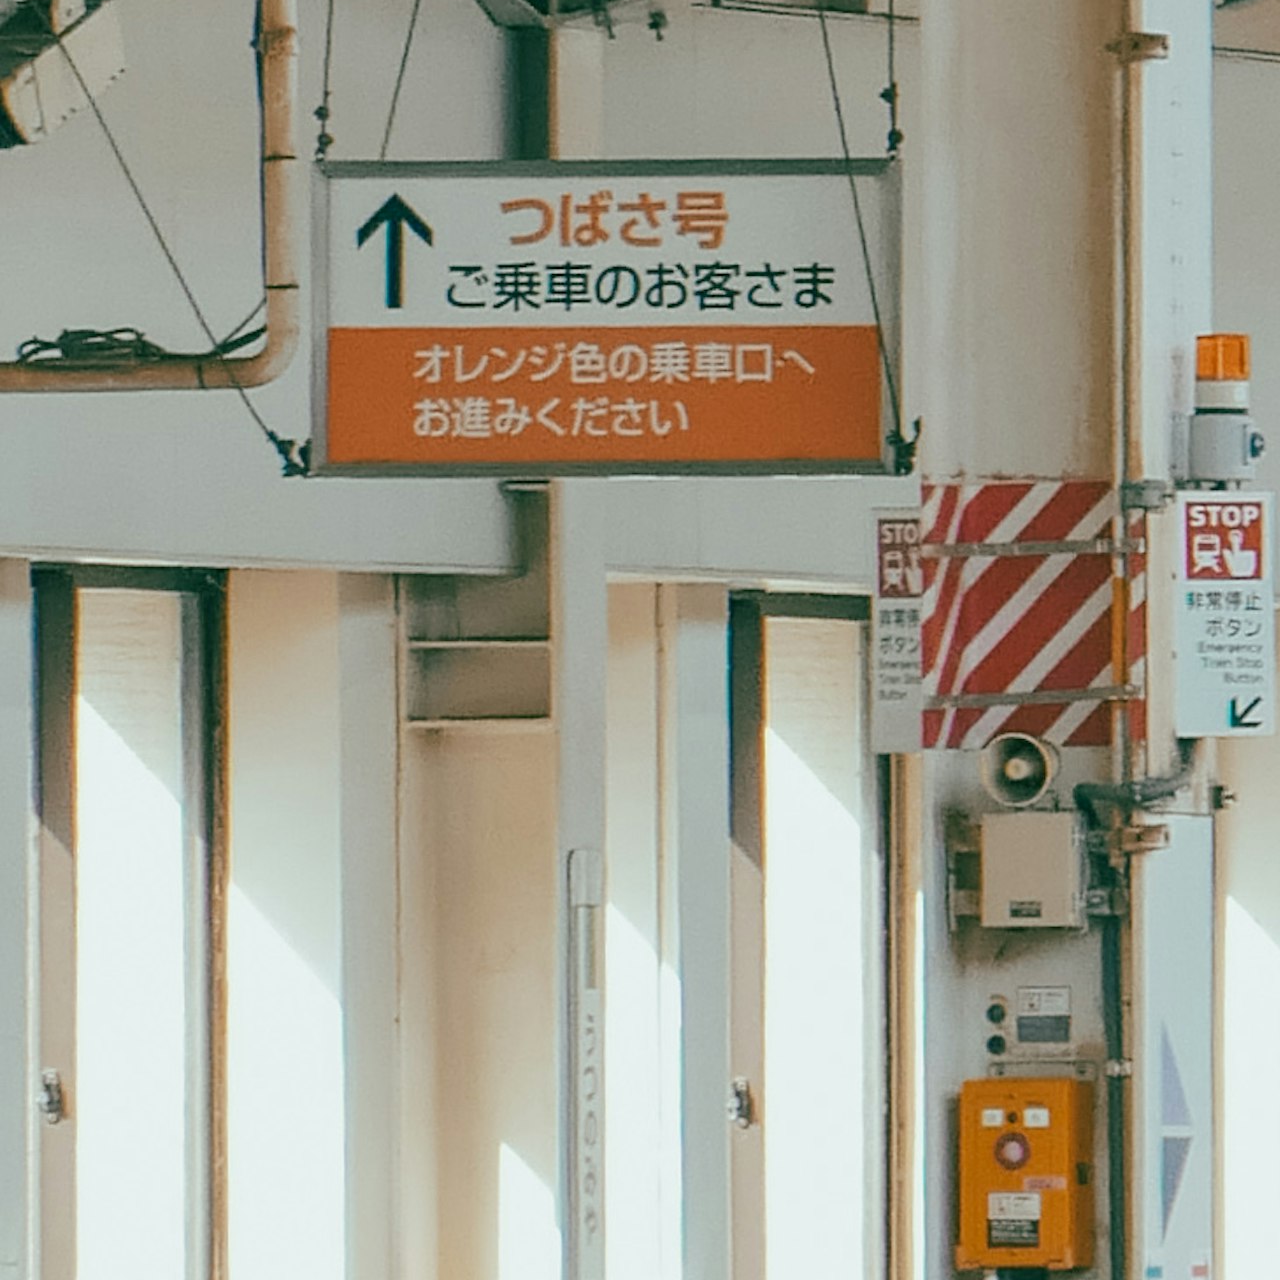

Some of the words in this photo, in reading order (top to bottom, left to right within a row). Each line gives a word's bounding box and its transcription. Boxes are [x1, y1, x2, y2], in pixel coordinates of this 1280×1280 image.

[500, 191, 730, 250] つばさ号
[445, 261, 836, 311] ご乗車のお客さま
[412, 341, 816, 385] オレンジ色の乗車口へ
[412, 396, 690, 439] お進みください
[1188, 505, 1260, 527] STOP
[880, 523, 919, 544] STO
[1186, 591, 1263, 612] 非常停止
[1205, 618, 1262, 638] ボタン
